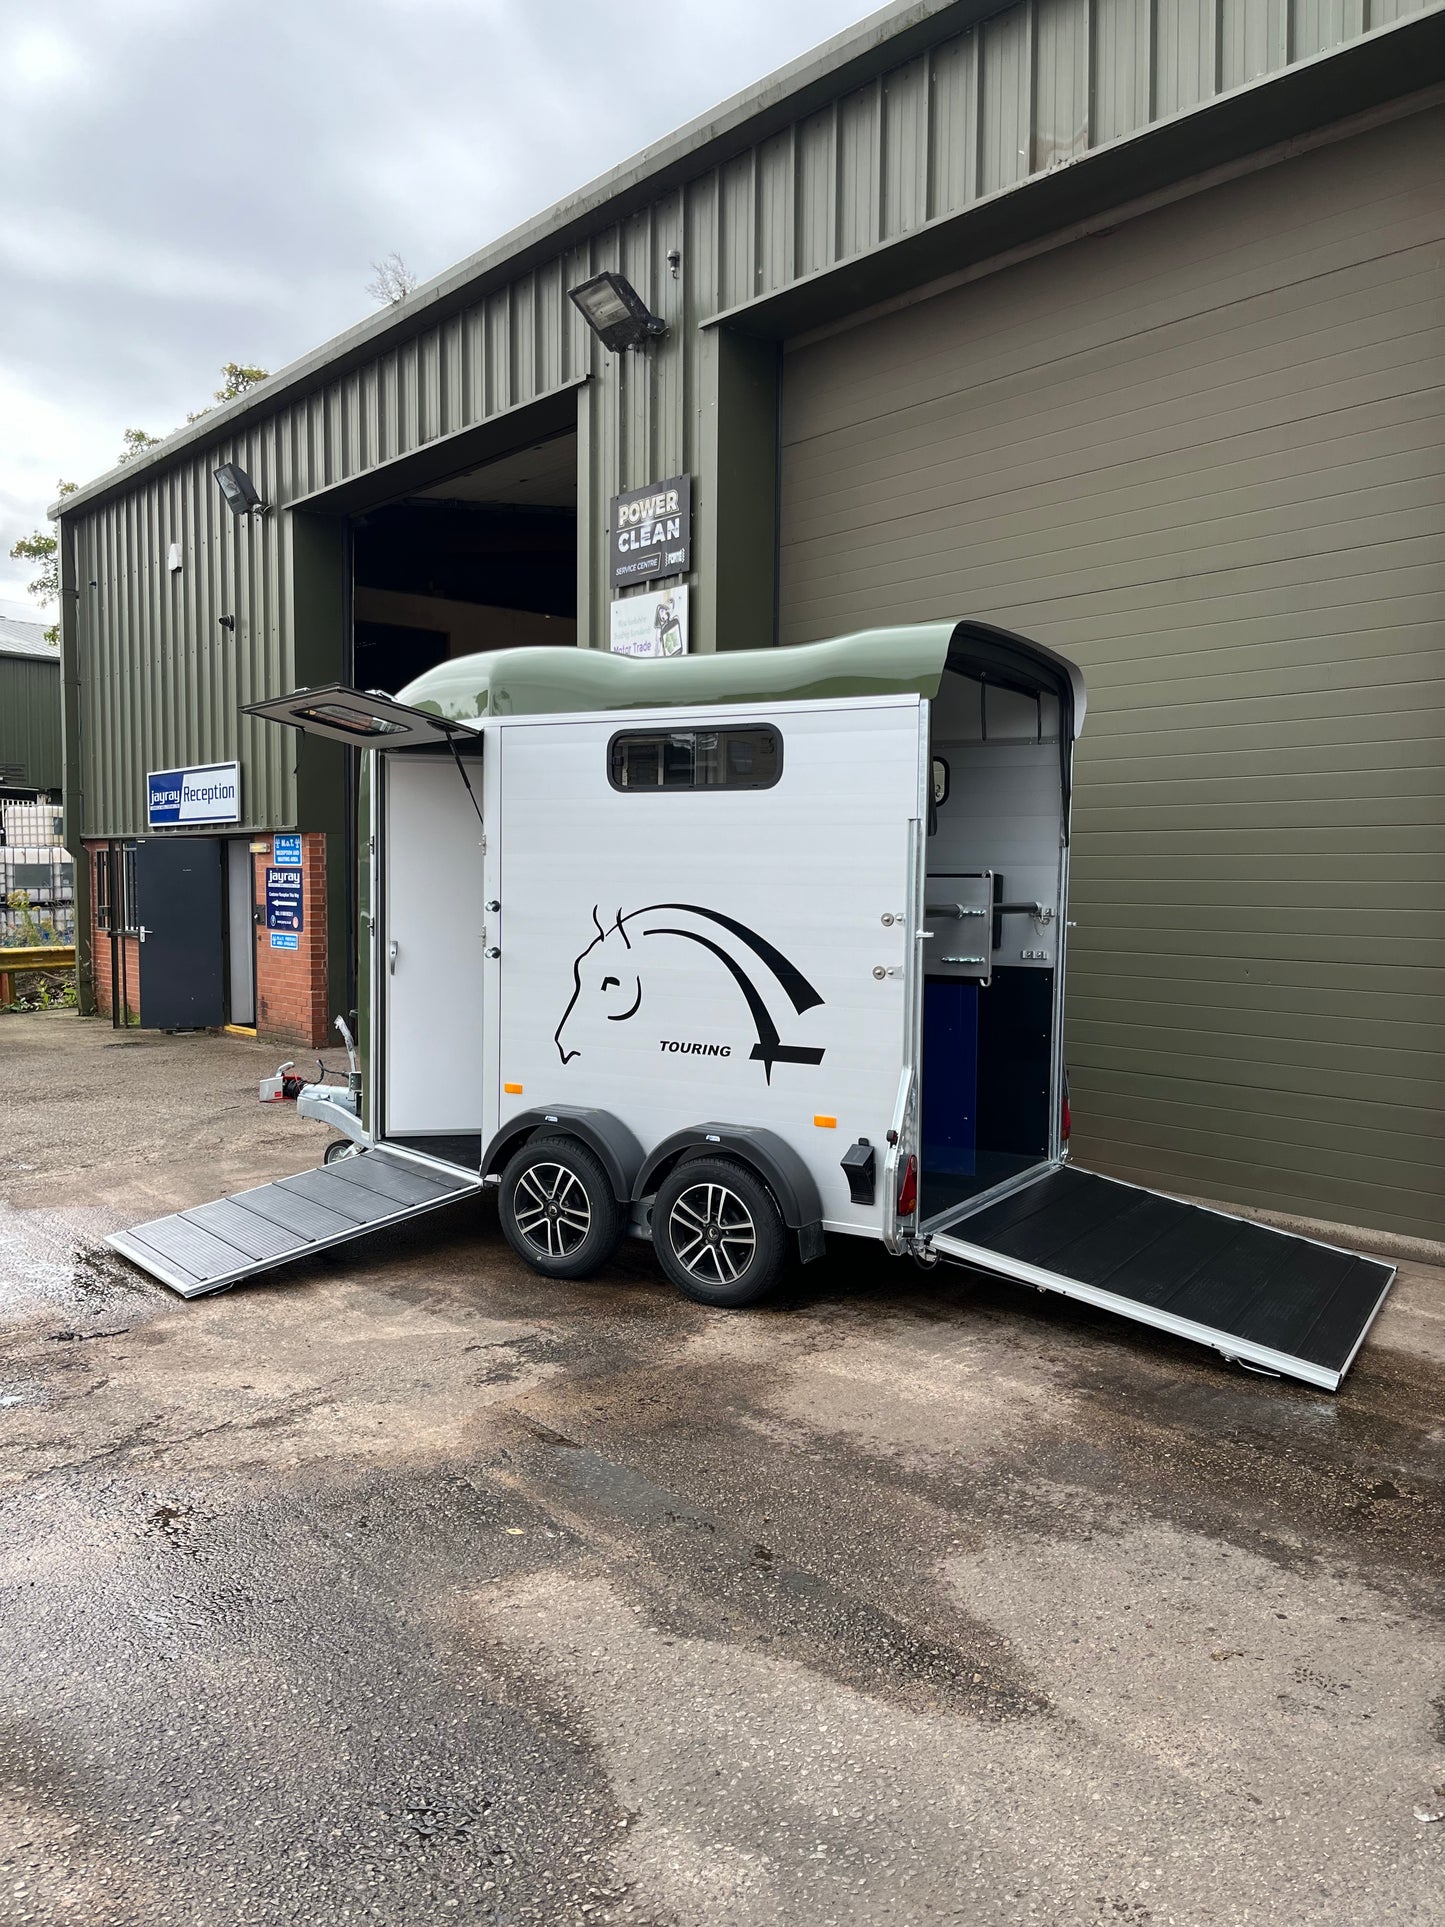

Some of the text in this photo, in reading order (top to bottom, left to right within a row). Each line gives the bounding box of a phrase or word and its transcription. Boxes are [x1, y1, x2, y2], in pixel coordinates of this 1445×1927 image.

[618, 489, 680, 528] POWER
[618, 518, 680, 552] CLEAN
[616, 558, 658, 576] SERVICE CENTRE
[633, 641, 652, 654] Trade
[150, 783, 234, 805] jayray Reception
[268, 870, 300, 884] jayray
[660, 1041, 732, 1057] TOURING
